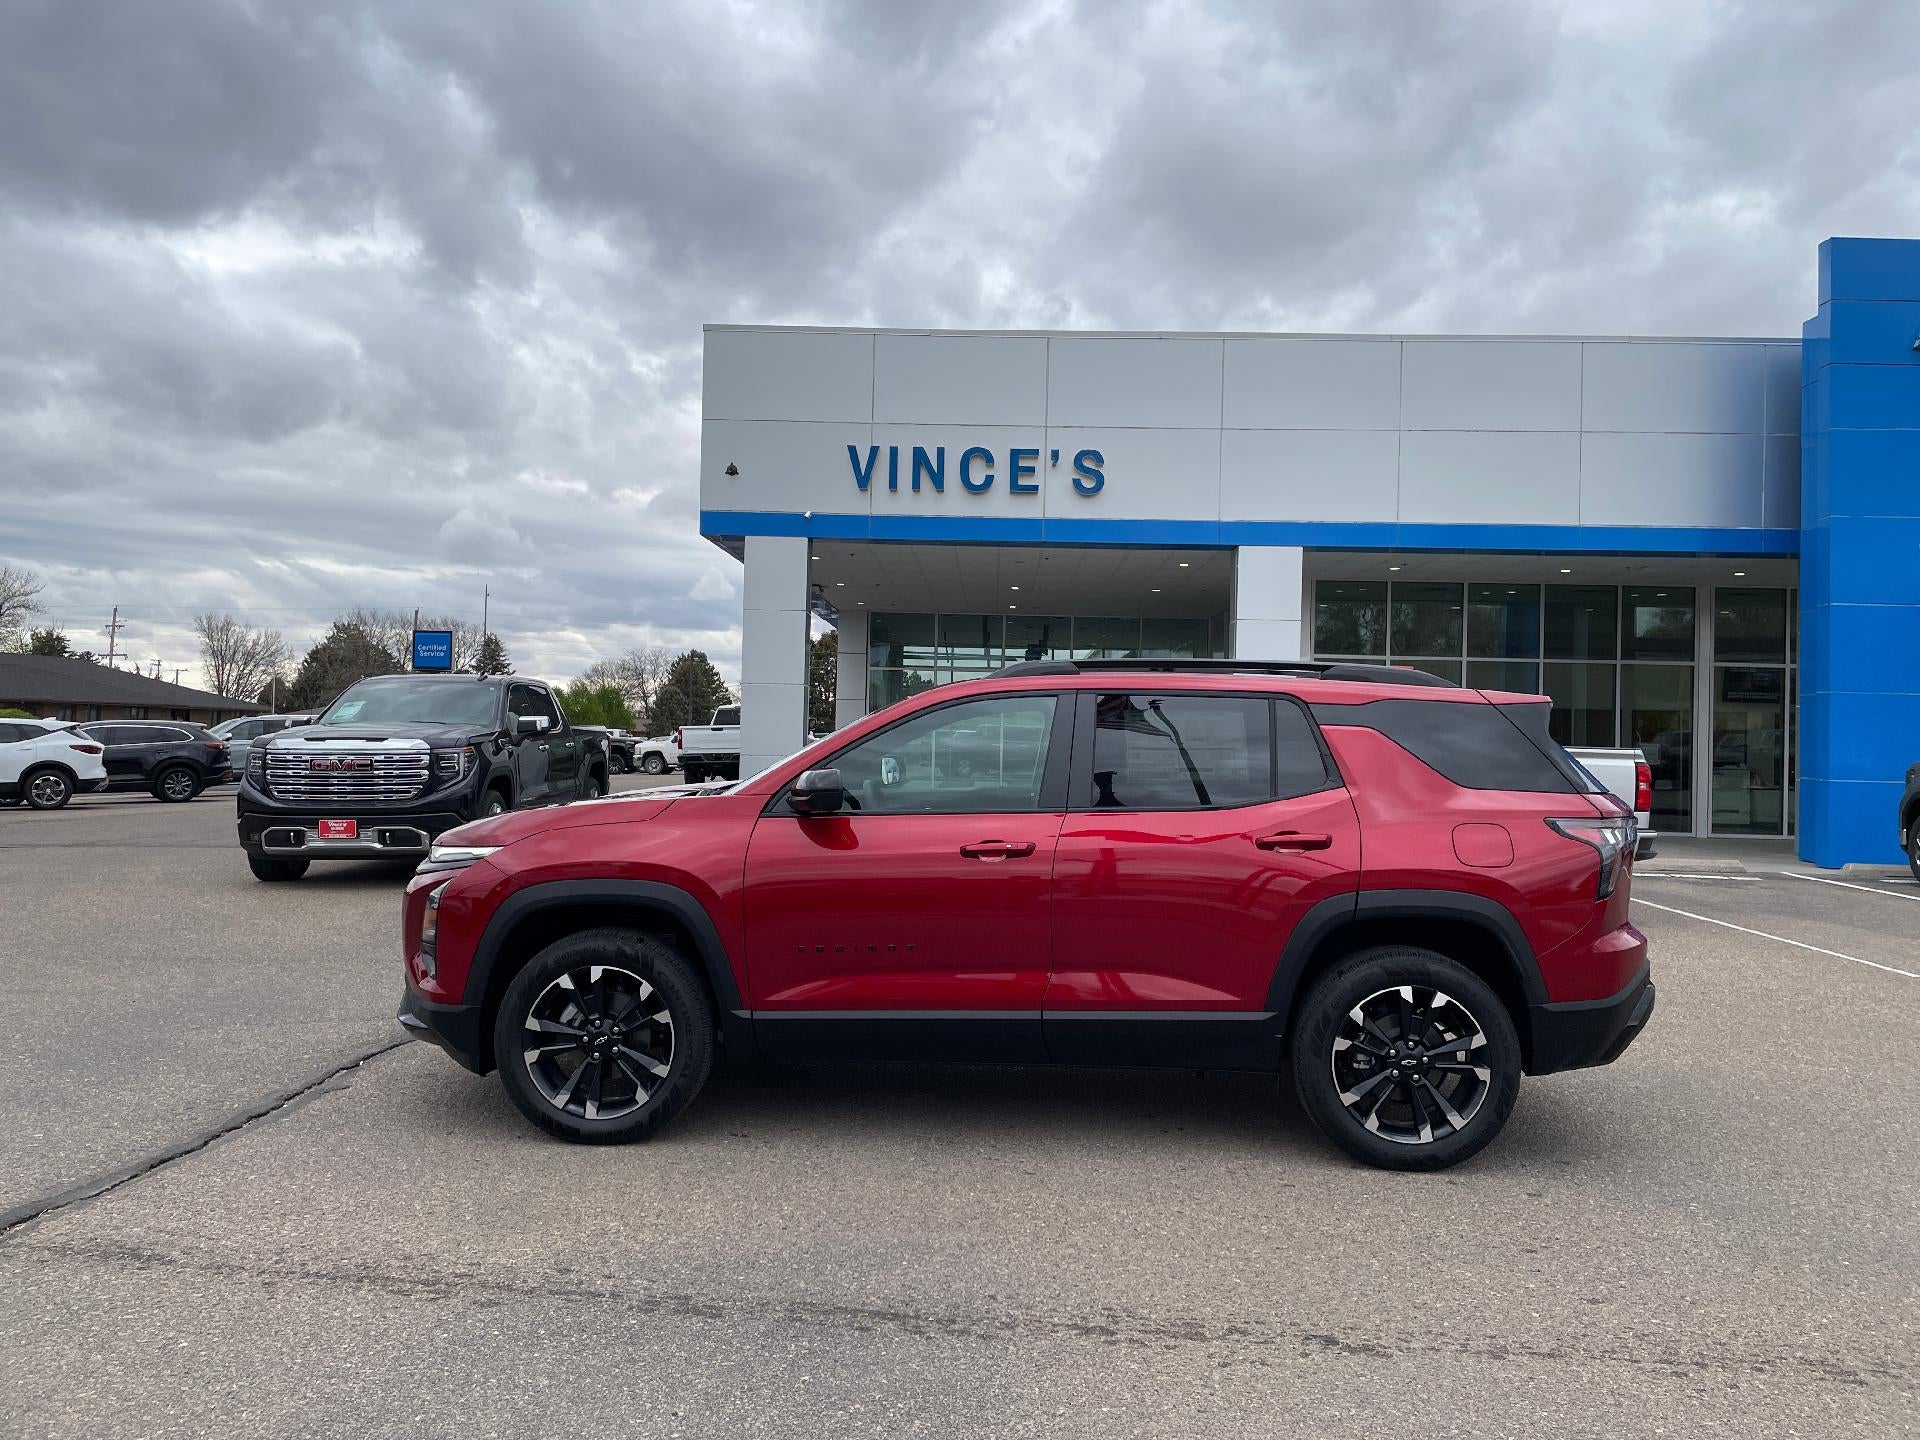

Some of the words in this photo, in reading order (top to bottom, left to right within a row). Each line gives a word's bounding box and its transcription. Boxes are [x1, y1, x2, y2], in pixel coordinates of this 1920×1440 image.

[847, 444, 1106, 496] VINCE'S
[311, 759, 371, 771] GMC
[796, 944, 917, 953] EQUINOX
